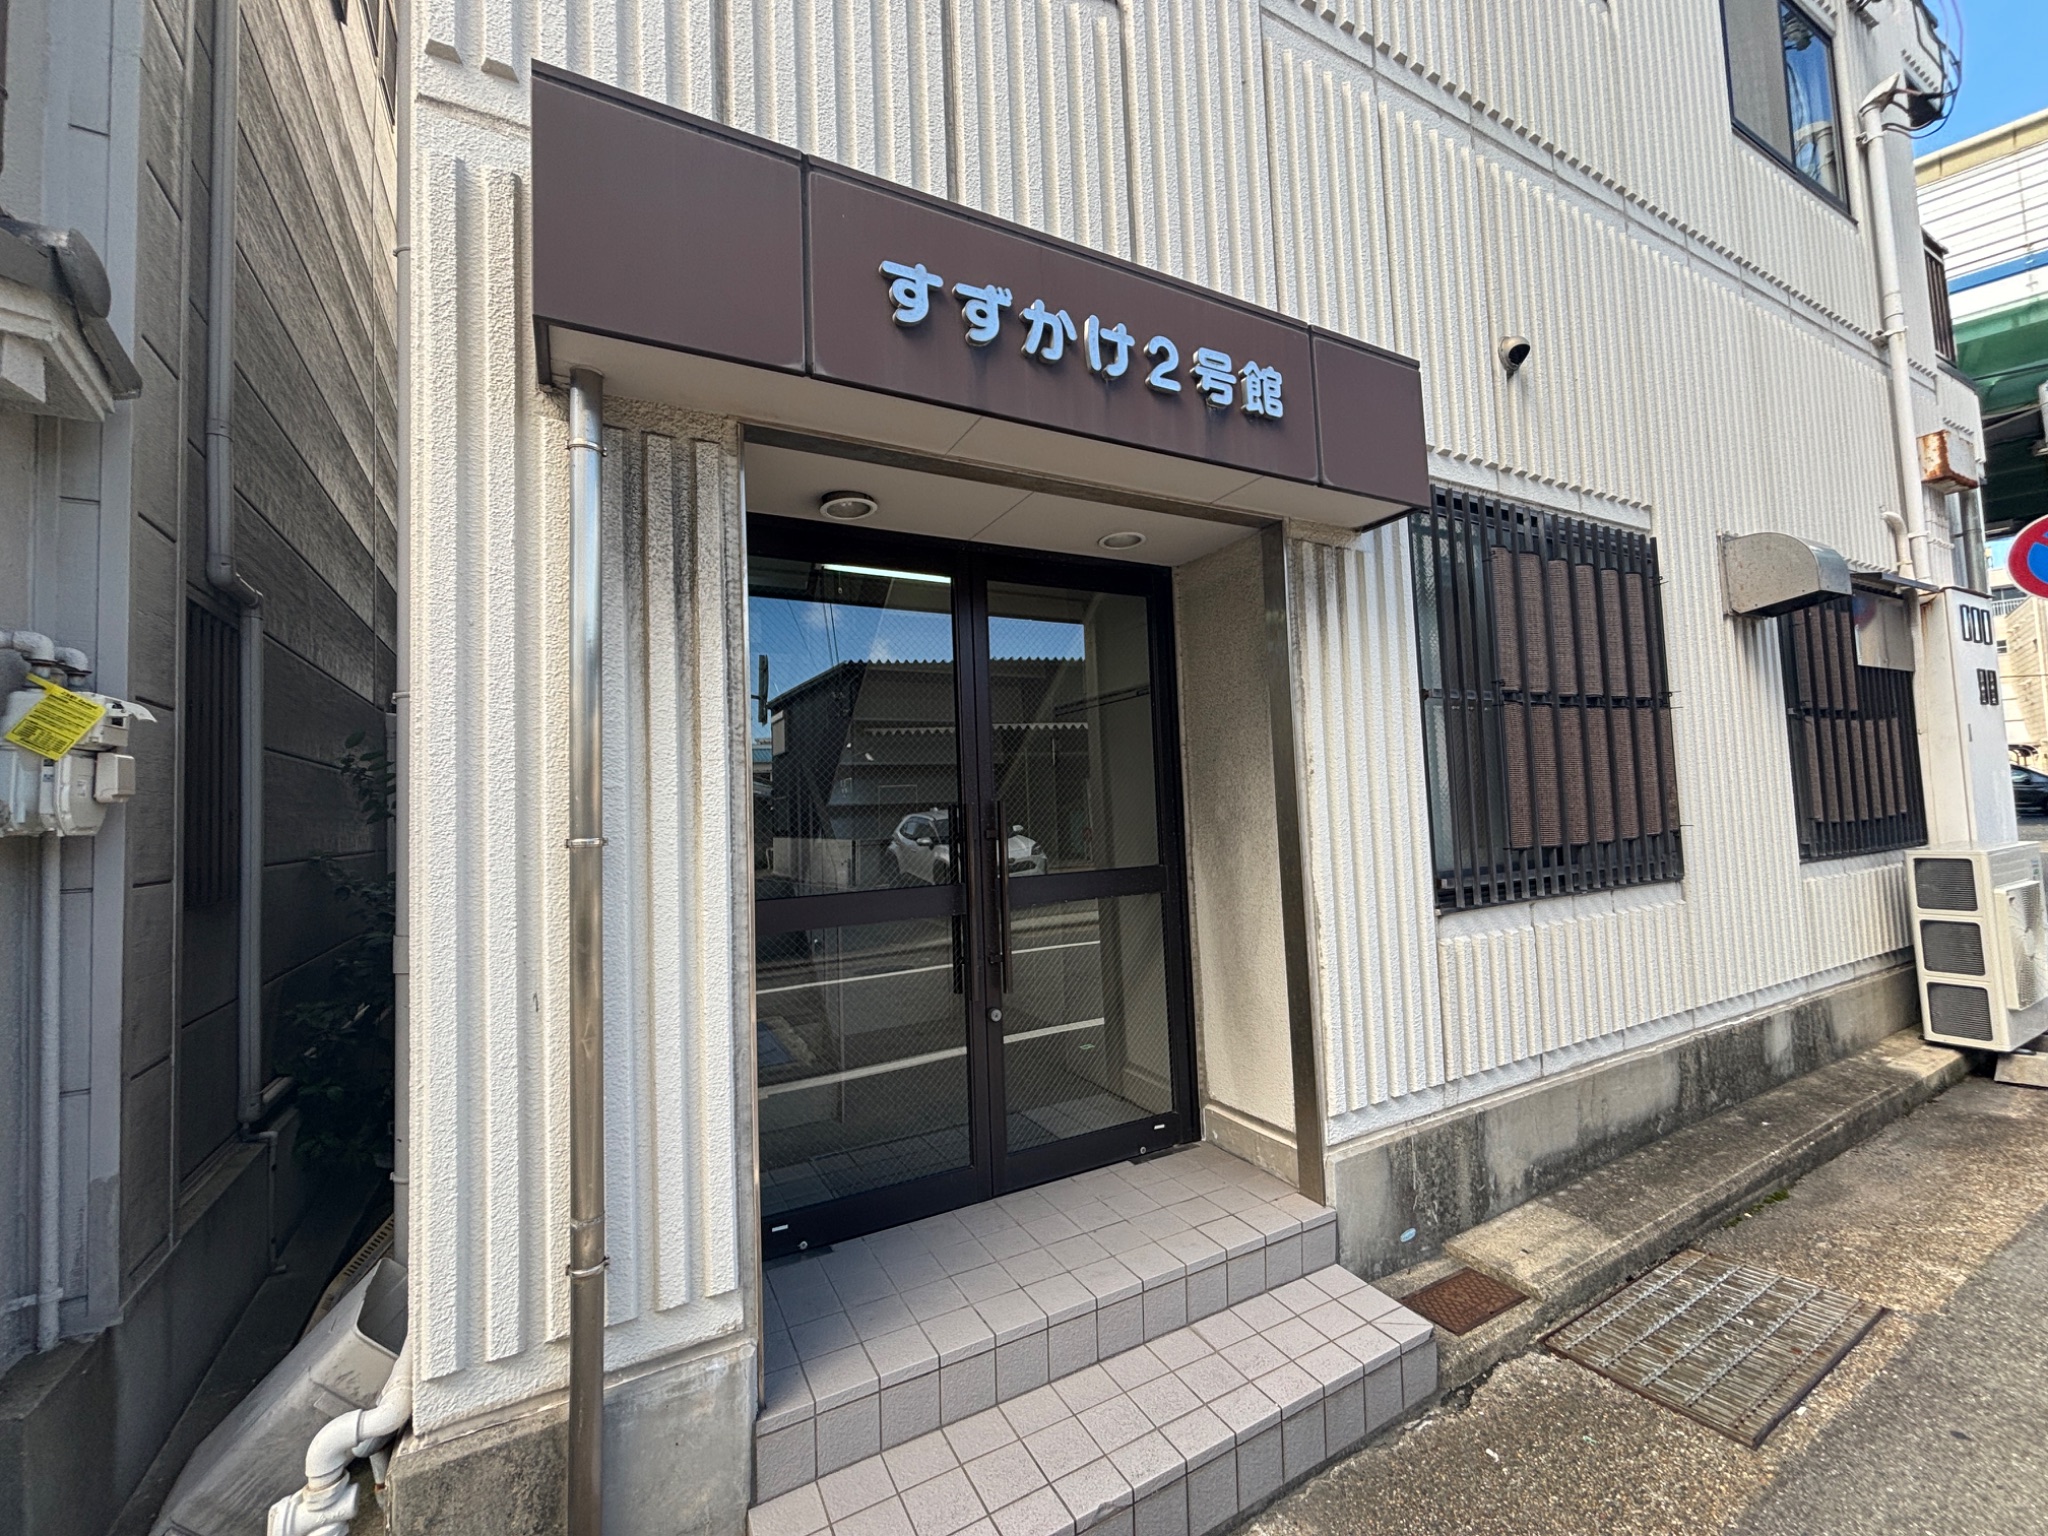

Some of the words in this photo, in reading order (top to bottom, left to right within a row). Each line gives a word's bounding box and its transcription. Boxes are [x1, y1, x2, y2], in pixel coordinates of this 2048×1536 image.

[879, 260, 1284, 419] すずかけ2号館
